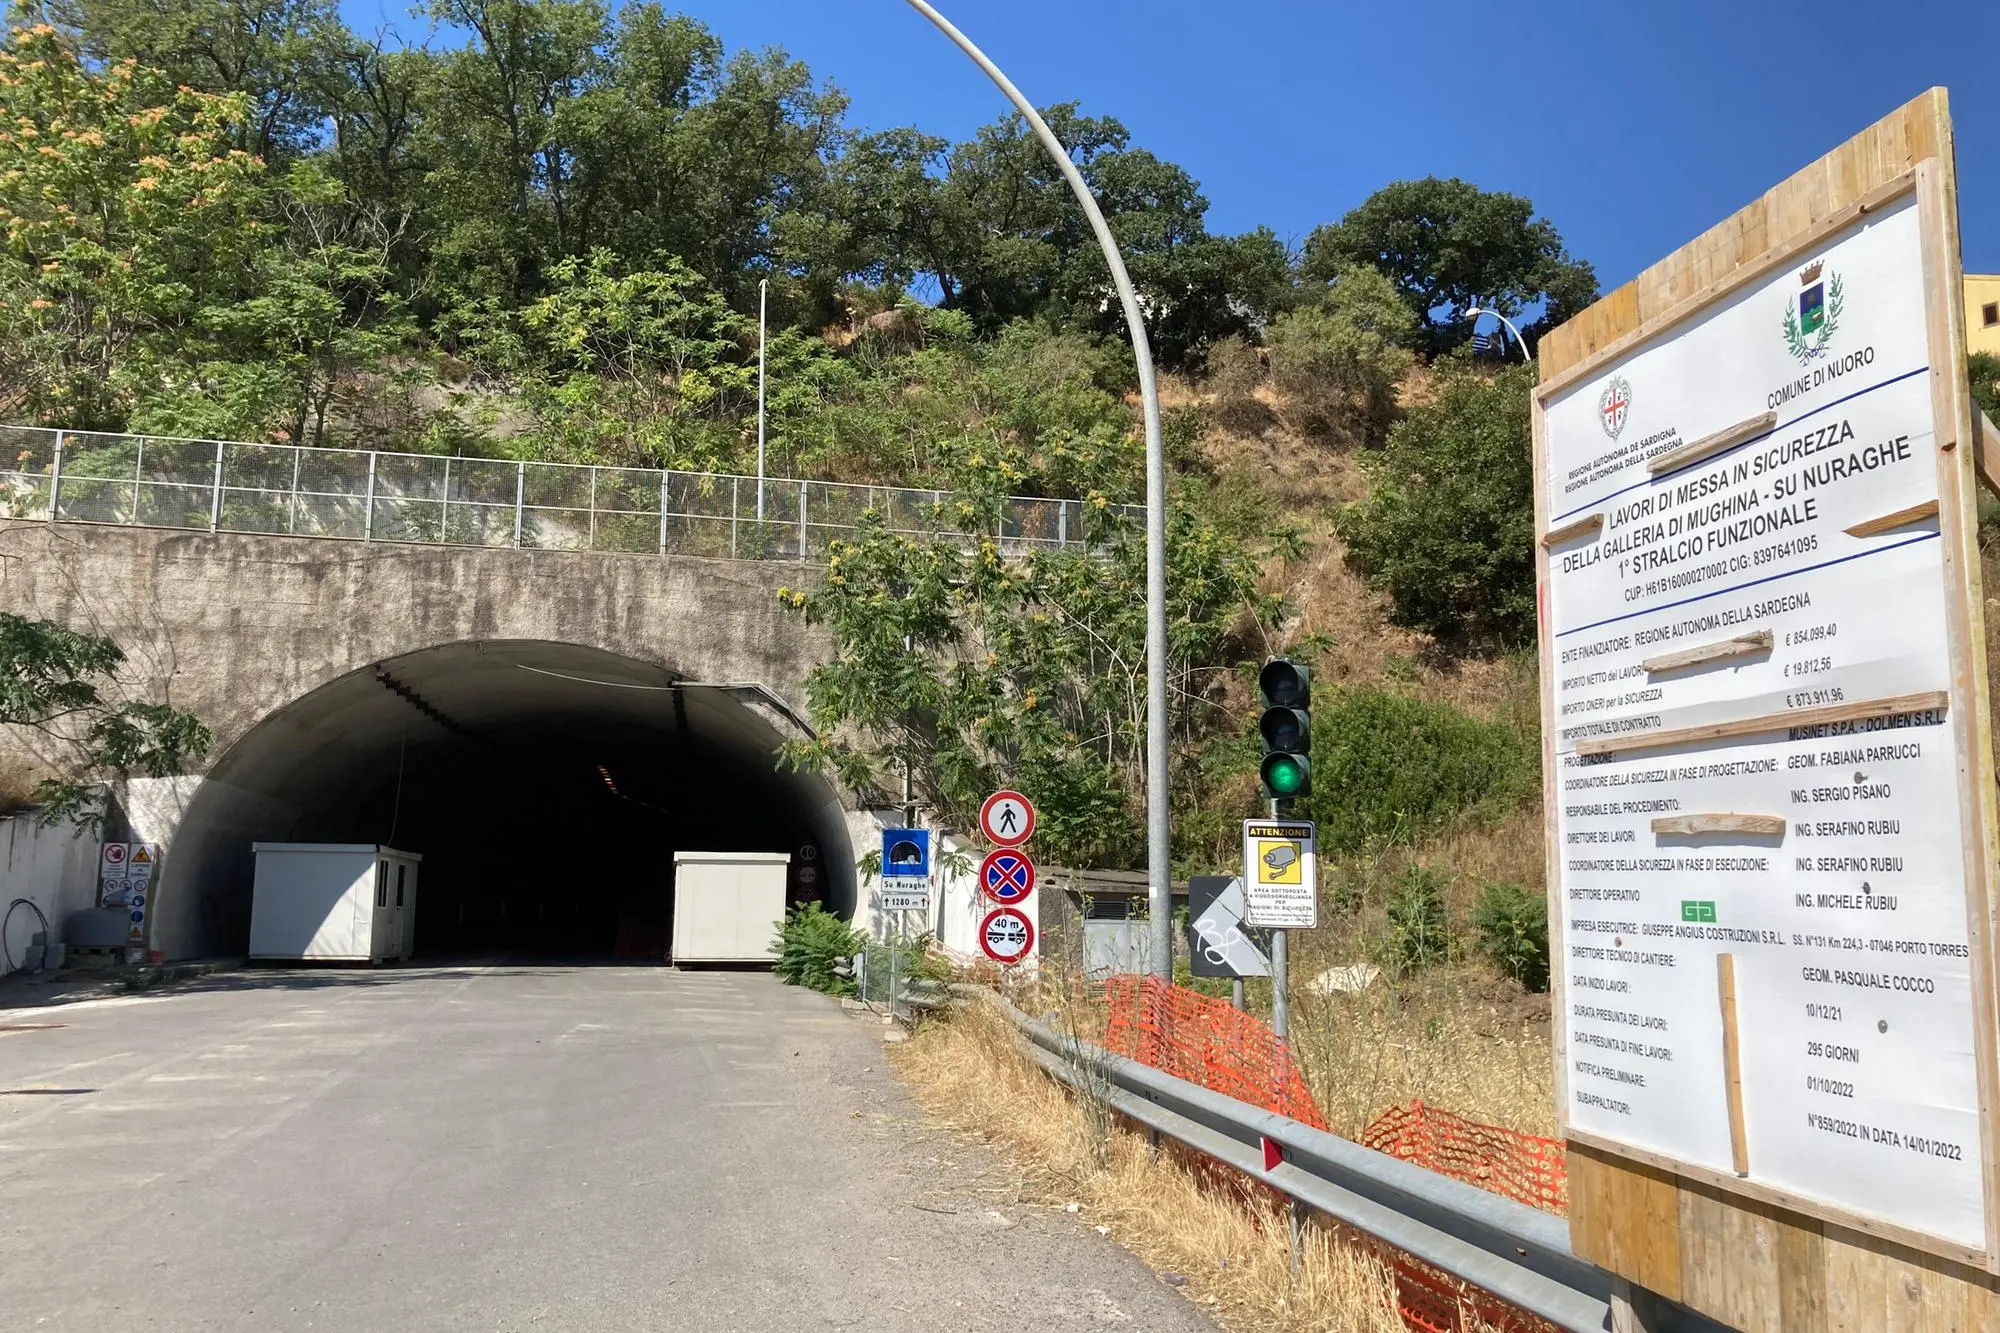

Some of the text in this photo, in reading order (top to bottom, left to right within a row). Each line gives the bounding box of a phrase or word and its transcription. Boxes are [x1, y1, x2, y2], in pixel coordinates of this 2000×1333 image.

[1768, 347, 1874, 409] COMUNE DI NUORO
[1569, 427, 1676, 480] REGIONE AUTONOMA DE SARDIGNA
[1565, 438, 1683, 494] REGIONE AUTONOMA DELLA SARDEGNA
[1609, 420, 1854, 529] LAVORI DI MESSA IN SICUREZZA
[1563, 435, 1911, 573] DELLA GALLERIA DI MUGHINA SU NURAGHE
[1634, 536, 1701, 574] STRALCIO
[1708, 498, 1818, 552] FUNZIONALE
[1625, 586, 1644, 602] CUP:
[1730, 555, 1751, 572] CIG:
[1753, 534, 1818, 566] 8397641095
[1562, 592, 1811, 663] ENTE FINANZIATORE: REGIONE AUTONOMA DELLA SARDEGNA
[1786, 623, 1836, 646] € 854.099,40
[1784, 657, 1831, 677] € 19.812,56
[1562, 676, 1585, 691] IMPORTO
[1586, 672, 1606, 685] NETTO
[1608, 670, 1618, 681] dei
[1562, 688, 1663, 716] IMPORTO ONERI per la SICUREZZA
[1787, 688, 1843, 707] € 873.911,96
[1562, 715, 1661, 740] IMPORTO TOTALE DI CONTRATTO
[1789, 710, 1946, 741] MUSINET S.P.A. DOLMEN S.R.L.
[1788, 743, 1920, 769] GEOM. FABIANA PARRUCCI
[1565, 758, 1779, 790] COORDINATORE DELLA SICUREZZA IN FASE DI PROGETTAZIONE:
[1791, 784, 1891, 803] ING. SERGIO PISANO
[1566, 799, 1681, 817] RESPONSABILE DEL PROCEDIMENTO:
[1567, 830, 1635, 844] DIRETTORE DEI LAVORI
[1796, 820, 1900, 836] ING. SERAFINO RUBIU
[1569, 858, 1769, 871] COORDINATORE DELLA SICUREZZA IN FASE DI ESECUZIONE:
[1796, 857, 1903, 872] ING. SERAFINO RUBIU
[897, 881, 925, 890] Nuraghe
[1570, 889, 1640, 901] DIRETTORE OPERATIVO
[1796, 894, 1897, 910] ING. MICHELE RUBIU
[995, 919, 1007, 928] 40
[1571, 919, 1596, 932] IMPRESA
[1598, 920, 1638, 934] ESECUTRICE:
[1642, 924, 1674, 937] GIUSEPPE
[1675, 926, 1705, 939] ANGIUS
[1706, 927, 1760, 944] COSTRUZIONI
[1762, 931, 1786, 945] S.R.L.
[1792, 934, 1804, 946] SS.
[1828, 937, 1841, 949] Km
[1843, 938, 1863, 951] 224,3
[1870, 939, 1893, 952] 07046
[1895, 941, 1927, 955] PORTO
[1928, 942, 1969, 958] TORRES
[1572, 946, 1676, 967] DIRETTORE TECNICO DI CANTIERE:
[1573, 976, 1587, 988] DATA
[1588, 978, 1605, 990] INIZIO
[1803, 967, 1934, 993] GEOM. PASQUALE COCCO
[1574, 1005, 1668, 1031] DURATA PRESUNTA DEI LAVORI:
[1806, 1003, 1842, 1021] 10/12/21
[1574, 1032, 1673, 1061] DATA PRESUNTA DI FINE LAVORI:
[1808, 1042, 1859, 1063] 295 GIORNI
[1576, 1061, 1647, 1087] NOTIFICA PRELIMINARE:
[1807, 1076, 1853, 1098] 01/10/2022
[1576, 1091, 1631, 1115] SUBAPPALTATORI:
[1860, 1125, 1869, 1141] IN
[1873, 1127, 1901, 1147] DATA
[1903, 1135, 1962, 1160] 14/01/2022
